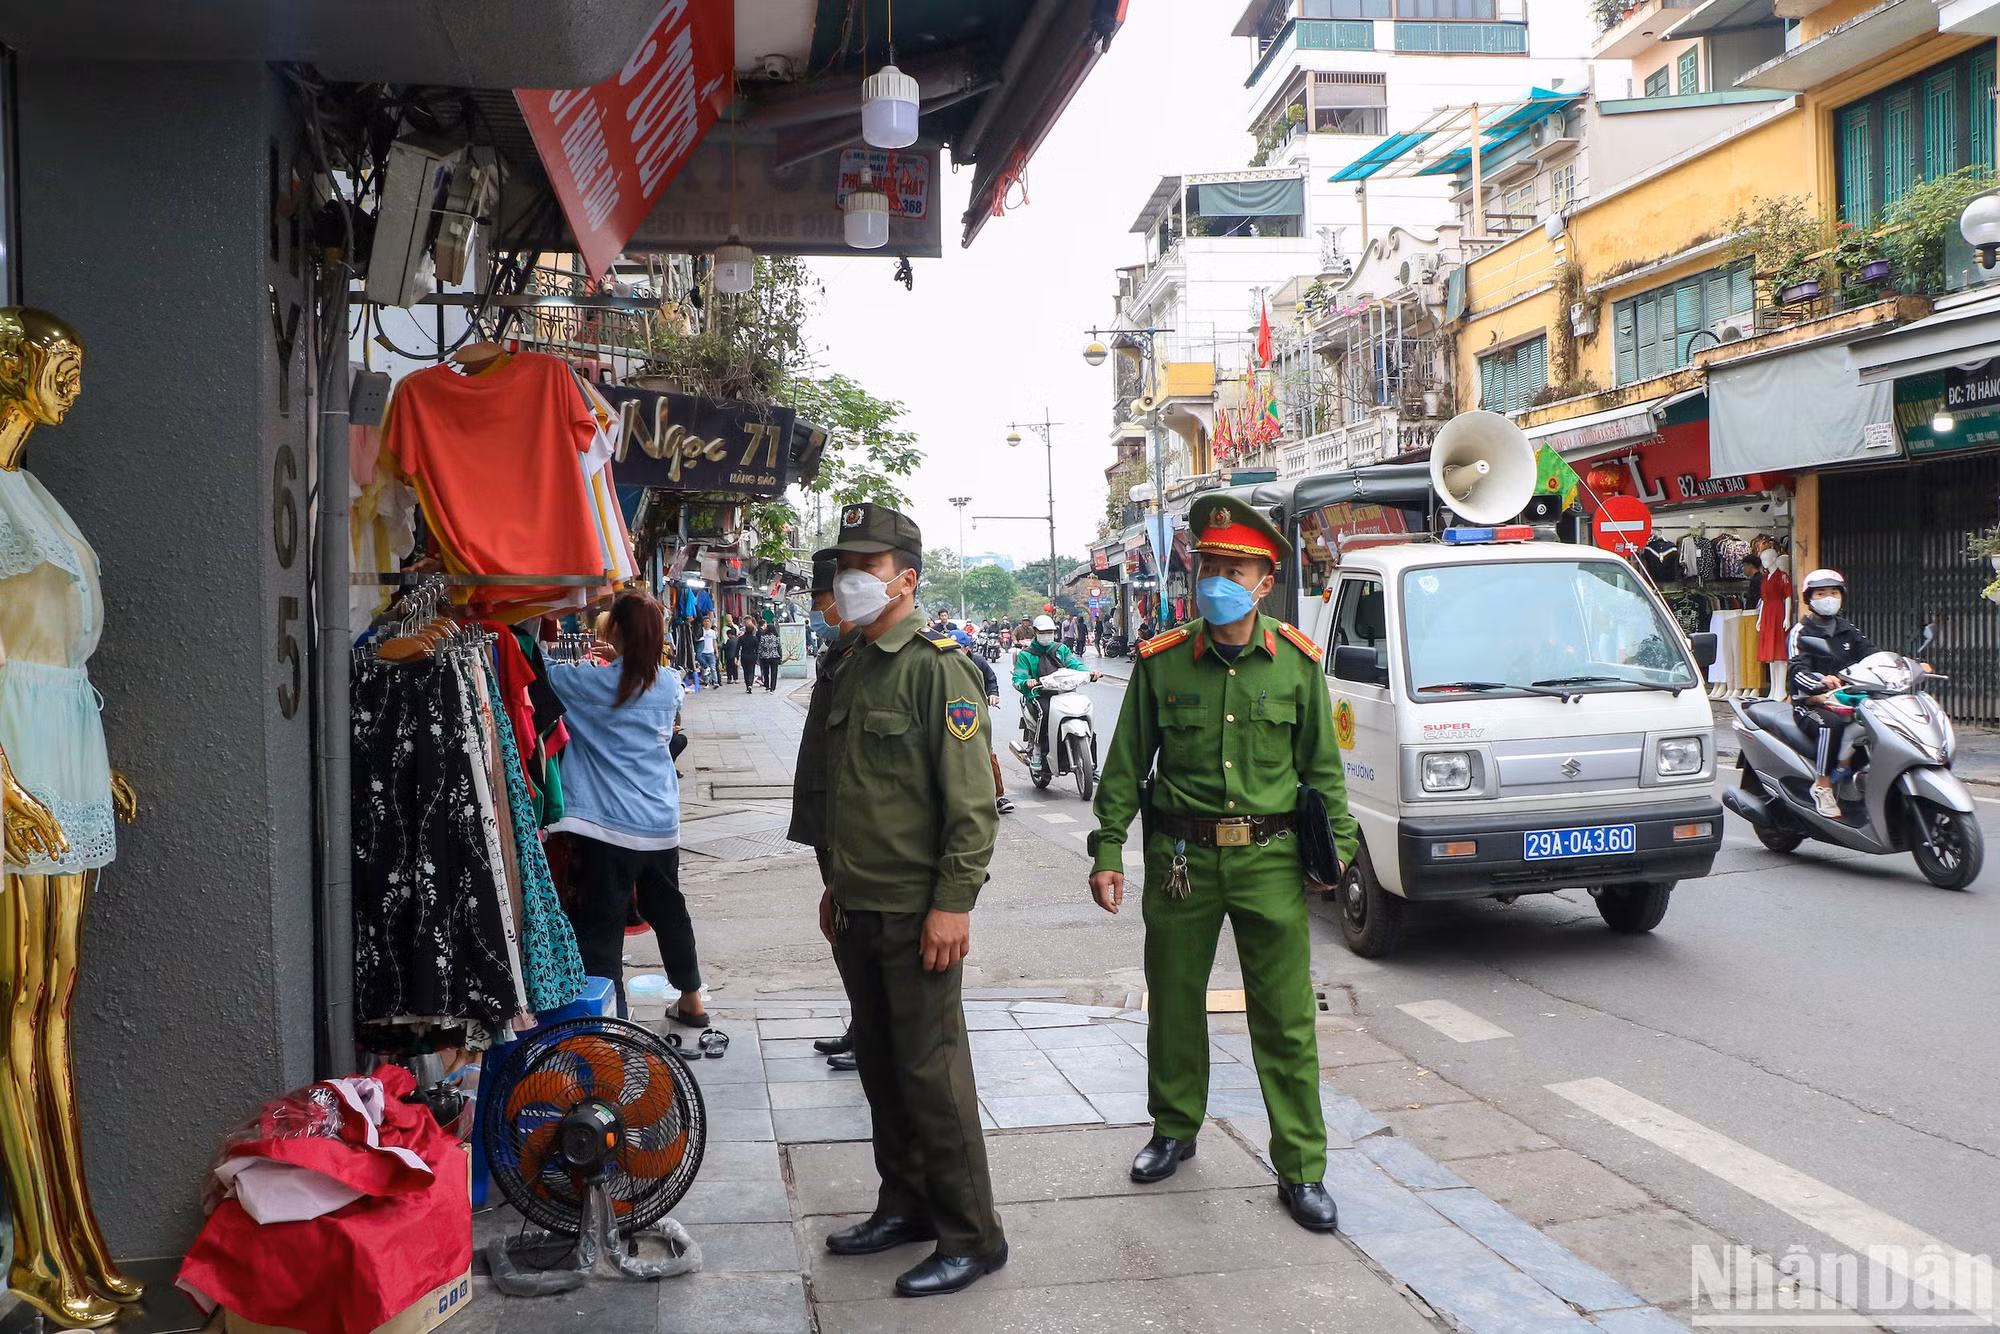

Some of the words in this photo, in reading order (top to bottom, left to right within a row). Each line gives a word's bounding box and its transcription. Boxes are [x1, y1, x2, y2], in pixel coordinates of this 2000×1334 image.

[561, 97, 608, 196] HÀNG
[582, 166, 623, 233] ĐÀO
[1948, 385, 1964, 404] ĐC:
[1966, 382, 1976, 402] 78
[615, 396, 728, 482] Ngọc
[740, 423, 781, 468] 71
[729, 470, 755, 485] HÀNG
[1677, 475, 1698, 498] 82
[1423, 722, 1470, 731] SUPER
[1423, 728, 1485, 740] CARRY
[1346, 760, 1375, 782] PHƯỜNG
[1527, 827, 1632, 857] 29A-043.60
